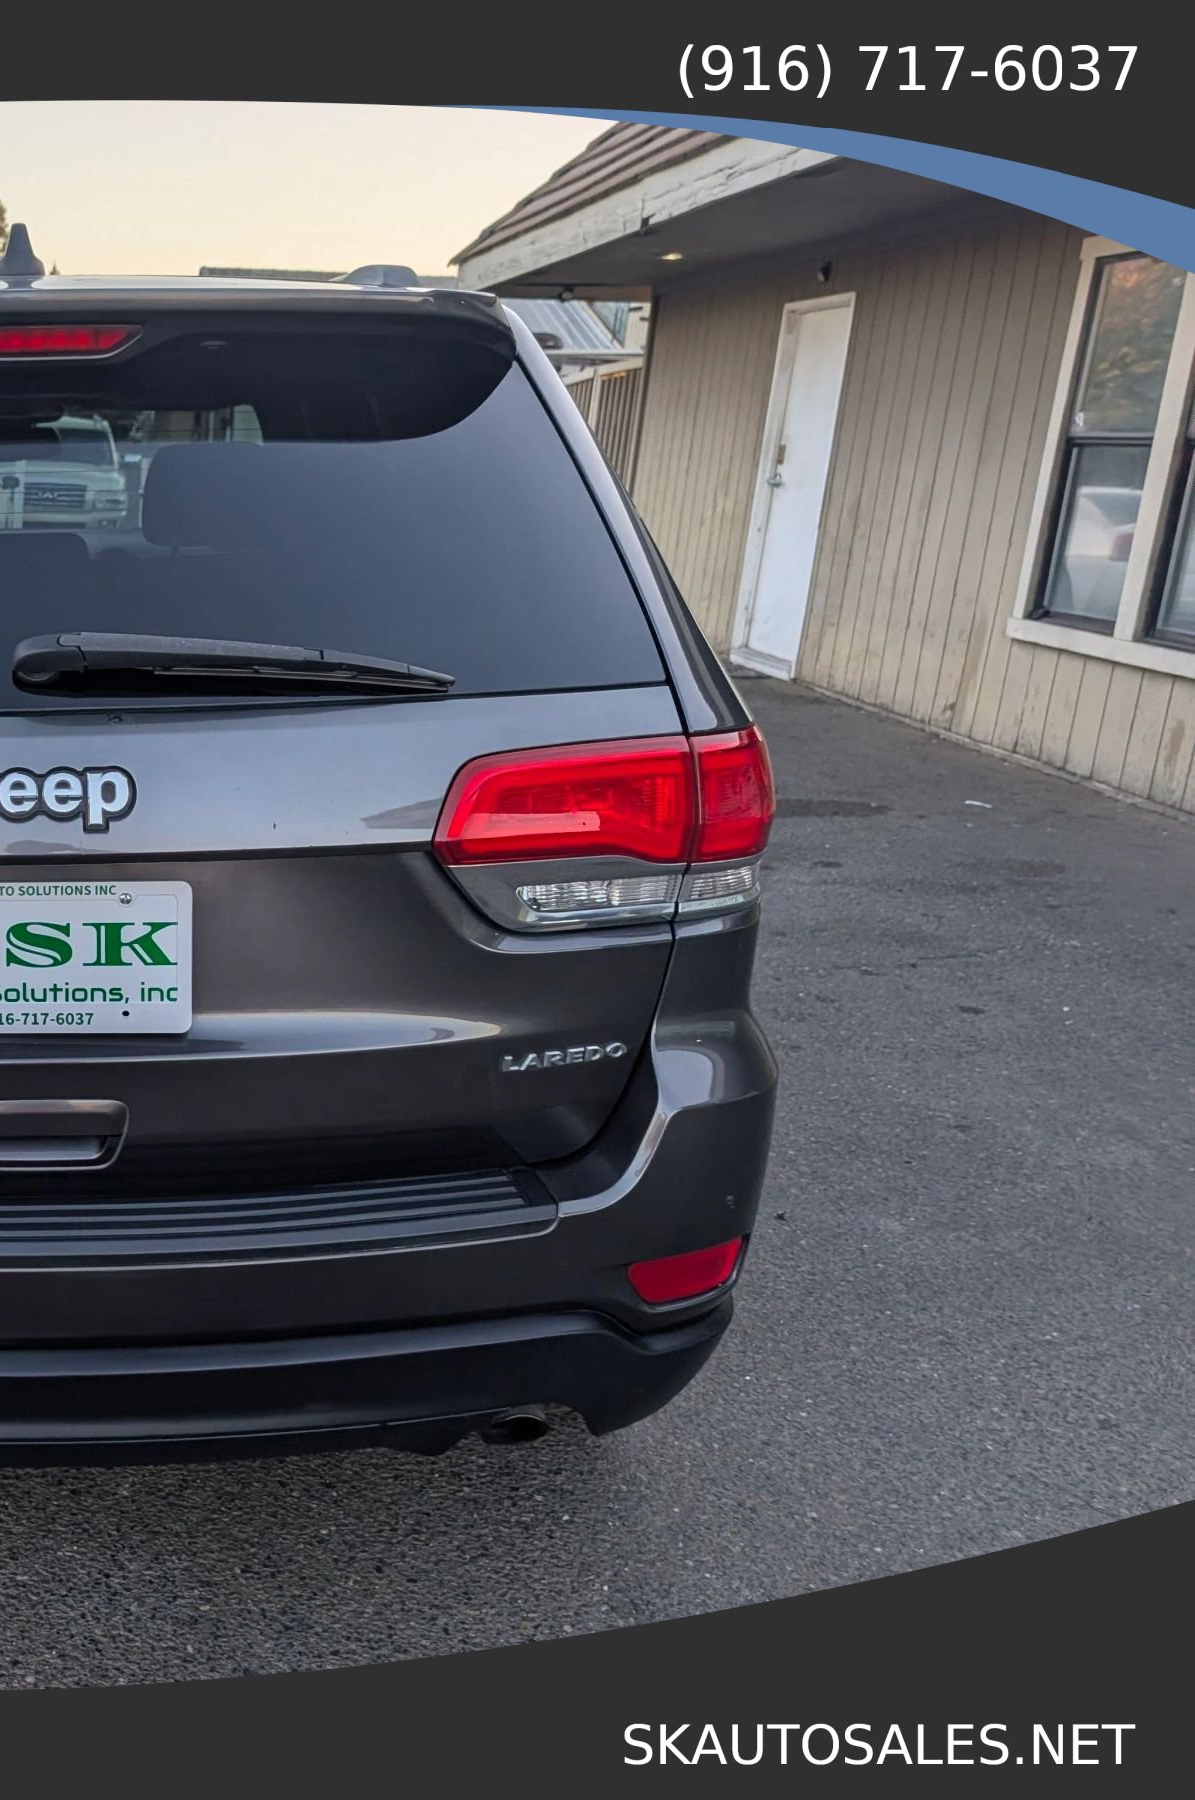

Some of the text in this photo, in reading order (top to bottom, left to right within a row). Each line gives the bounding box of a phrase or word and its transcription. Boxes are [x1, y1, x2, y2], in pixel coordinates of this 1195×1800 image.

[18, 885, 91, 897] SOLUTIONS
[94, 884, 117, 896] INC
[5, 921, 179, 969] SK
[140, 981, 178, 1003] inc
[501, 1042, 628, 1073] LAREDO
